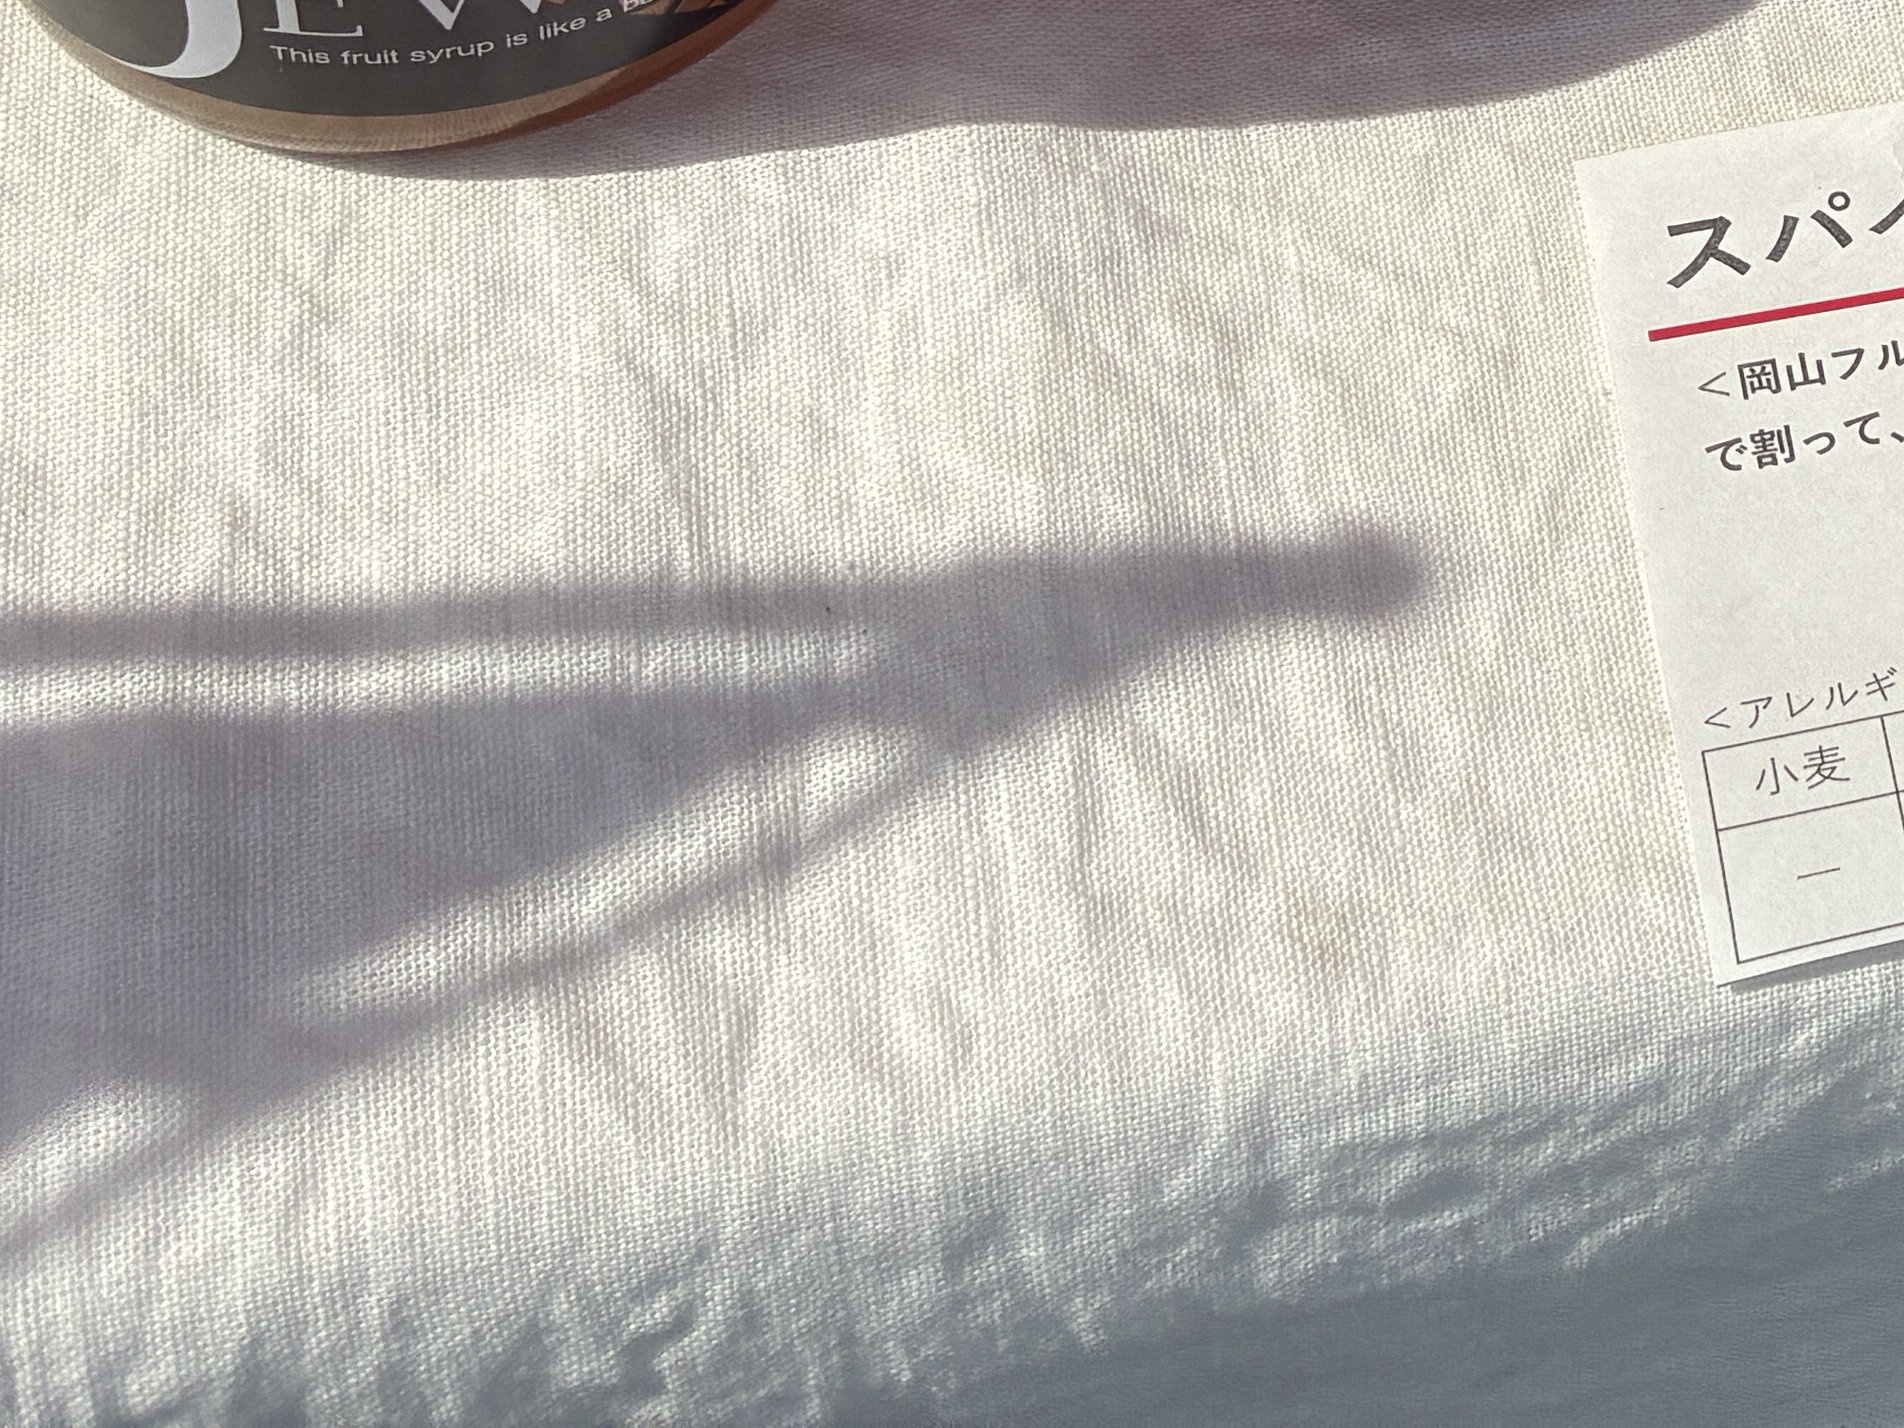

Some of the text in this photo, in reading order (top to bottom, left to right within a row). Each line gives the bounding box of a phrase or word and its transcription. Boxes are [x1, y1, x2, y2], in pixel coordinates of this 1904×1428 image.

[269, 44, 331, 65] This
[340, 46, 399, 66] fruit
[409, 39, 495, 66] syrup
[504, 31, 529, 48] is
[538, 15, 587, 43] like
[595, 7, 614, 24] a
[1754, 744, 1851, 797] 小麦
